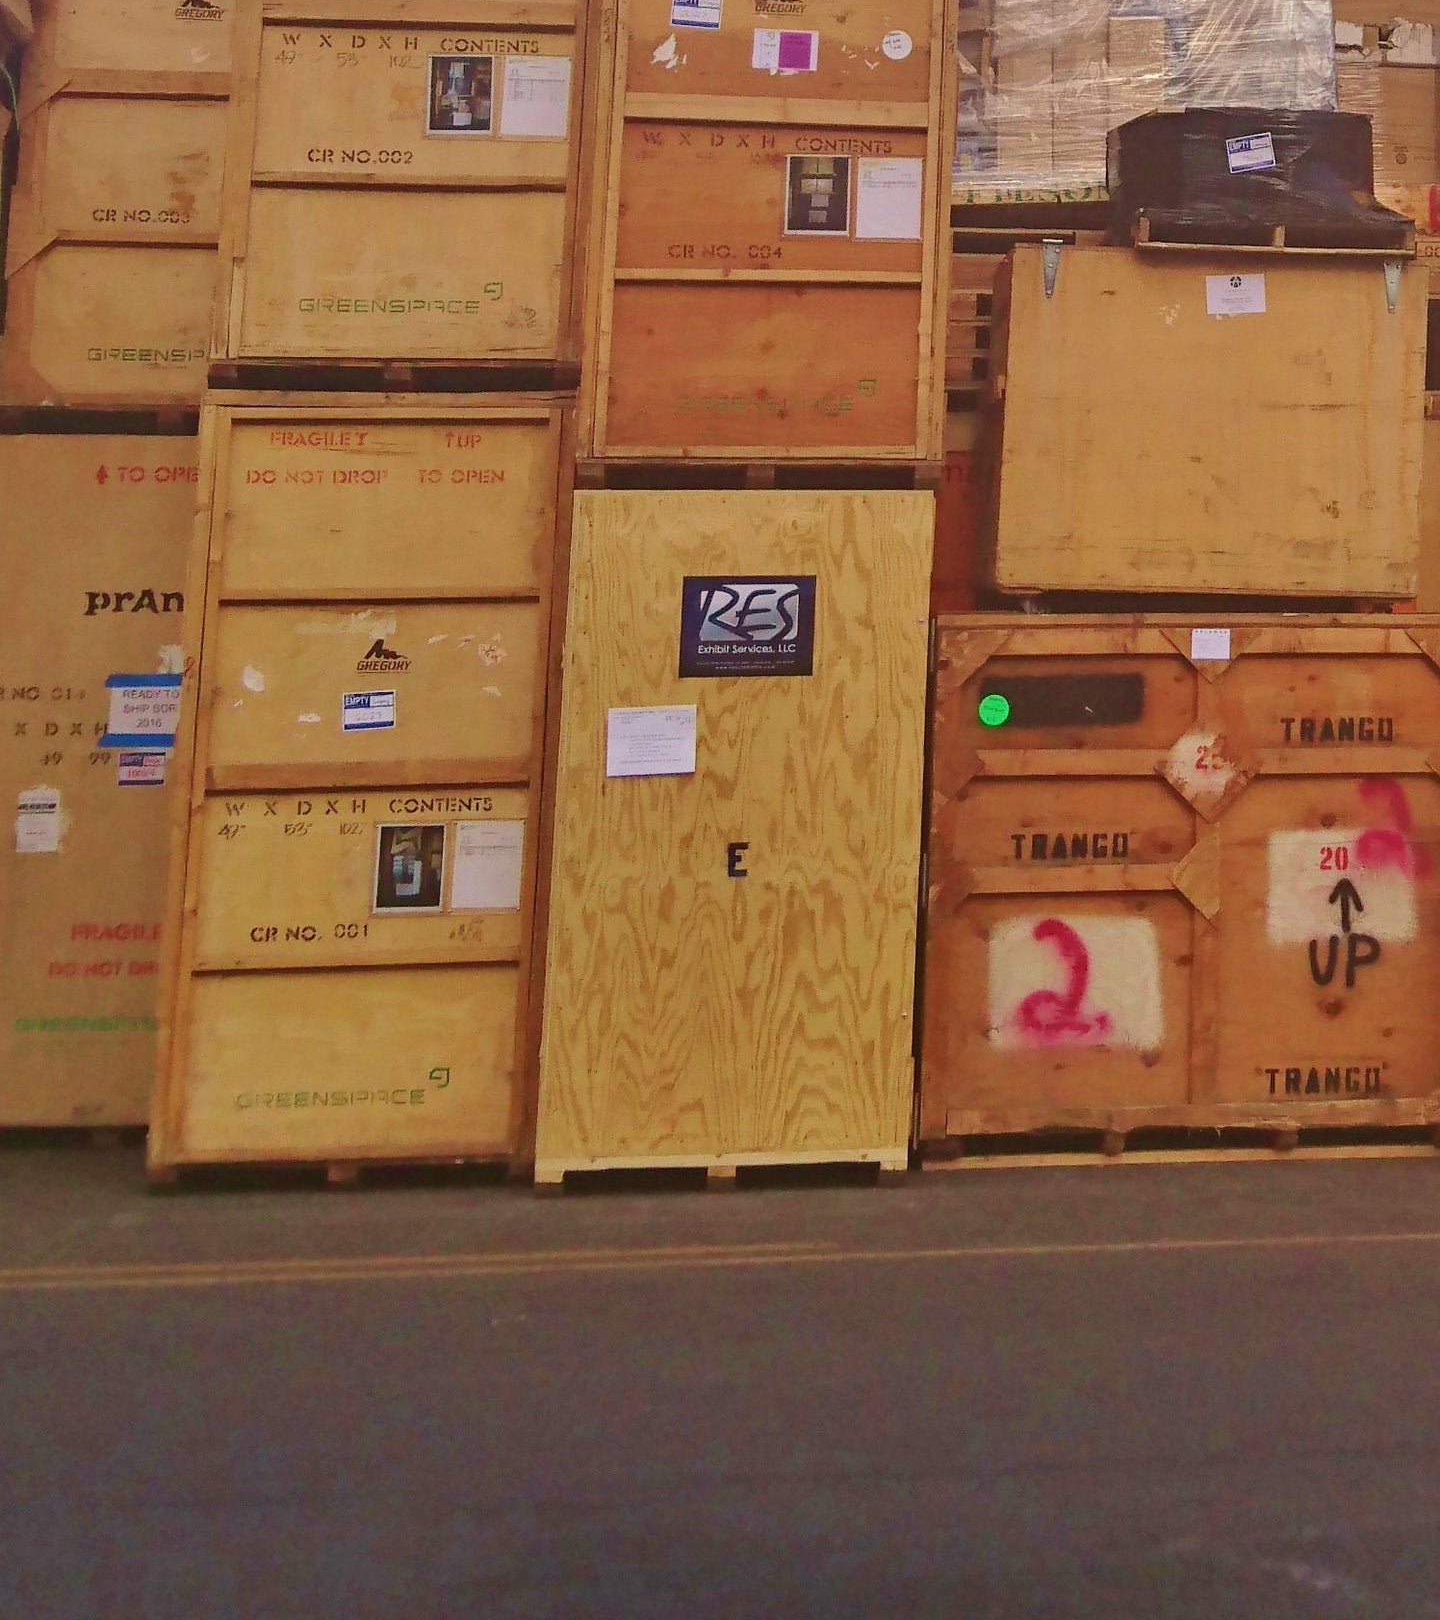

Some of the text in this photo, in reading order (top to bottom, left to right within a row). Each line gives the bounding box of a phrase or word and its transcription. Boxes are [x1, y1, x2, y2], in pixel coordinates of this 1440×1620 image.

[174, 7, 224, 20] GREGORY
[755, 3, 807, 14] GREGORY
[282, 33, 540, 54] W X D X H CONTENTS
[710, 134, 724, 148] D
[795, 137, 892, 154] CONTENTS
[307, 148, 334, 163] CR
[91, 209, 117, 222] CR
[668, 245, 695, 260] CR
[298, 297, 481, 315] GREENSPACE
[86, 347, 205, 363] GREENSP
[270, 430, 350, 447] FRAGILE
[456, 433, 482, 448] UP
[117, 465, 199, 482] TO OPE
[246, 469, 388, 485] DO NOT DROP
[418, 468, 506, 484] TO OPEN
[83, 588, 185, 617] prAn
[700, 583, 800, 641] RES
[698, 643, 797, 655] Exhibit Services, LLC
[356, 659, 413, 672] GREGORY
[122, 689, 181, 699] READY TO
[345, 695, 368, 706] EMPTY
[122, 704, 149, 713] SHIP
[1280, 716, 1394, 744] TRANGO
[226, 796, 494, 817] W X D X H CONTENTS
[1011, 833, 1129, 861] TRANGO
[727, 842, 750, 877] E
[1319, 846, 1350, 872] 20
[250, 925, 278, 943] CR
[333, 923, 370, 939] 001
[1308, 936, 1383, 989] UP
[1015, 918, 1115, 1038] 2
[1264, 1066, 1384, 1097] TRANGO
[233, 1087, 428, 1109] GREENSPACE
